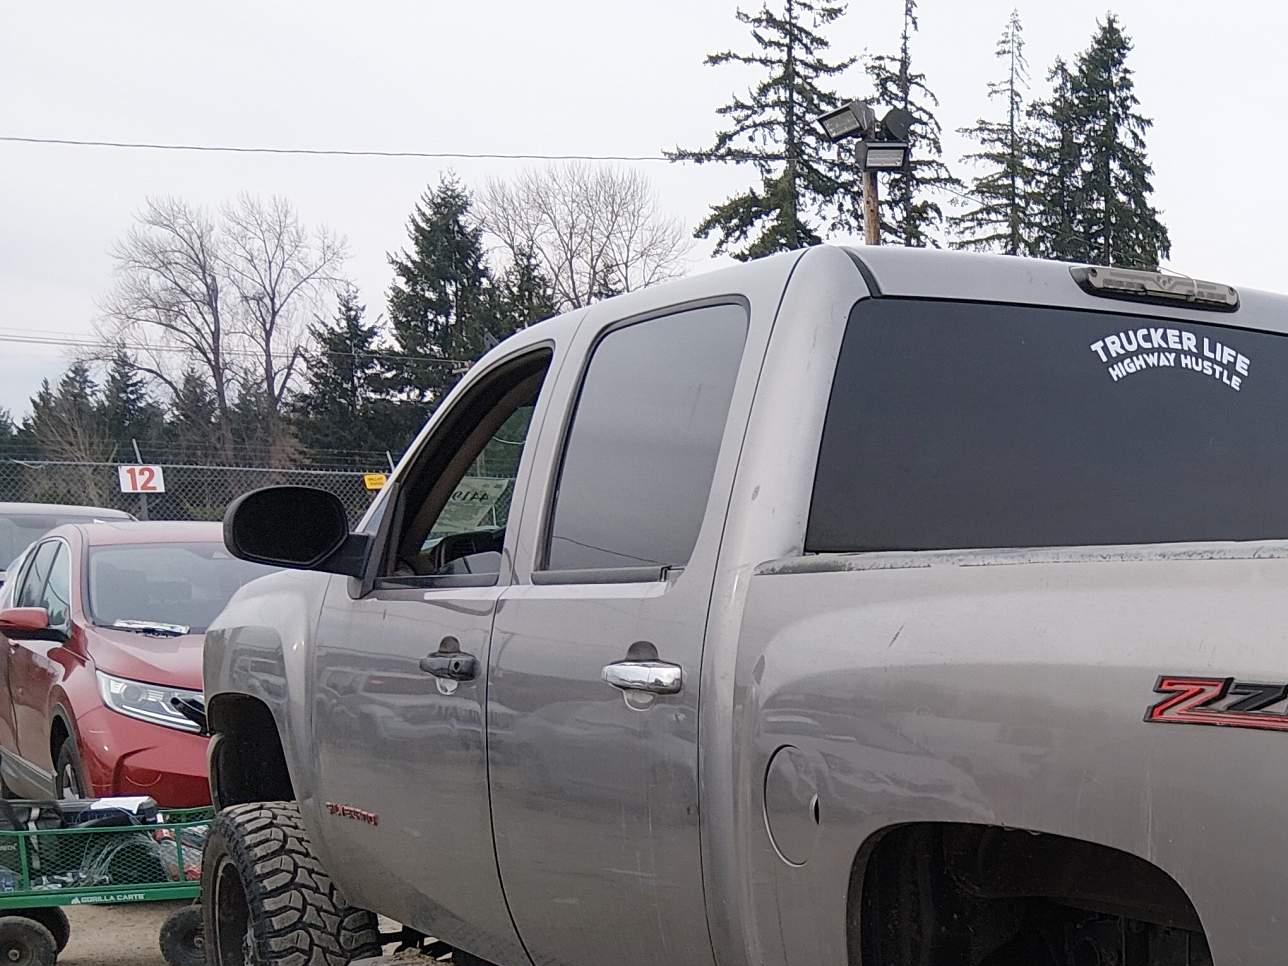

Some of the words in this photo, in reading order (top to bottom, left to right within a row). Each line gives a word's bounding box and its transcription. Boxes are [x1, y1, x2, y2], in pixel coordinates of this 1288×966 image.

[1090, 327, 1199, 363] TRUCKER
[1203, 337, 1251, 377] LIFE
[1108, 351, 1176, 382] HIGHWAY
[1180, 353, 1242, 391] HUSTLE
[126, 467, 157, 491] 12
[80, 895, 115, 903] GORILLA
